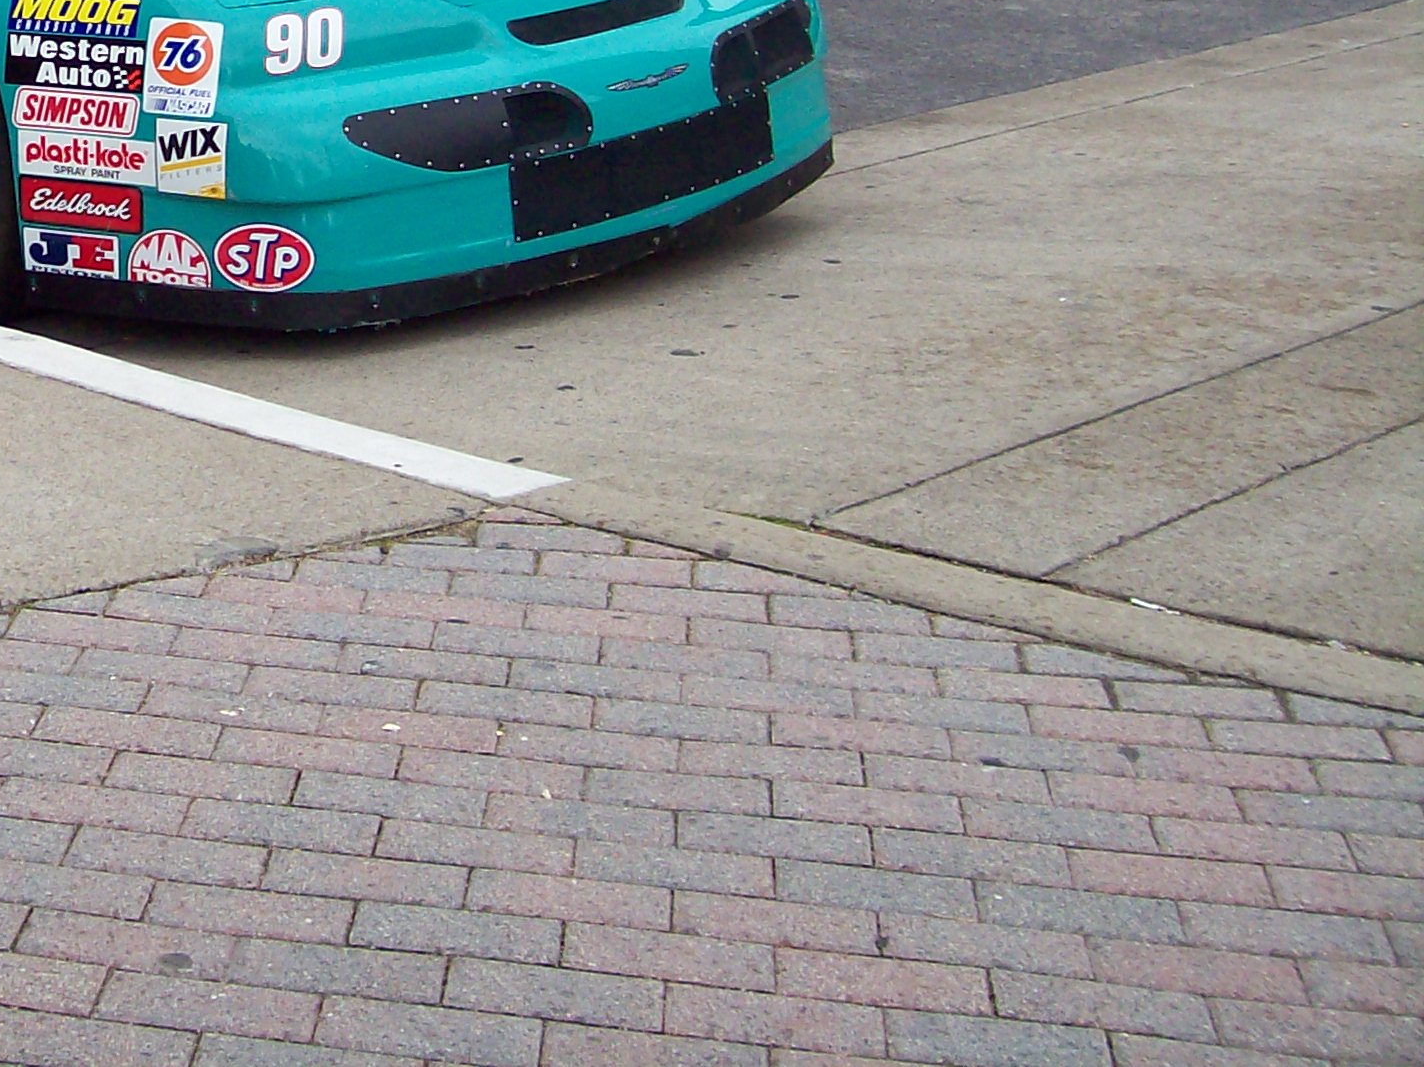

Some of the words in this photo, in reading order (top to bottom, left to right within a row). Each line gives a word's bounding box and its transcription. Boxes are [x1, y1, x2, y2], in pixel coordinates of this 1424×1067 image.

[16, 18, 77, 34] CHASSIS
[85, 23, 132, 37] PARTS
[264, 7, 344, 75] 90
[9, 34, 144, 65] Western
[158, 35, 207, 73] 76
[35, 61, 112, 88] Auto
[147, 85, 187, 96] OFFICIAL
[188, 88, 213, 98] FUEL
[22, 93, 128, 128] SIMPSON
[158, 126, 221, 162] WIX
[53, 165, 88, 177] SPRAY
[91, 168, 121, 180] PAINT
[29, 187, 132, 221] Edelbrock
[29, 232, 114, 273] JE
[132, 234, 207, 275] MAC
[226, 233, 300, 280] STP
[132, 269, 206, 287] TOOLS
